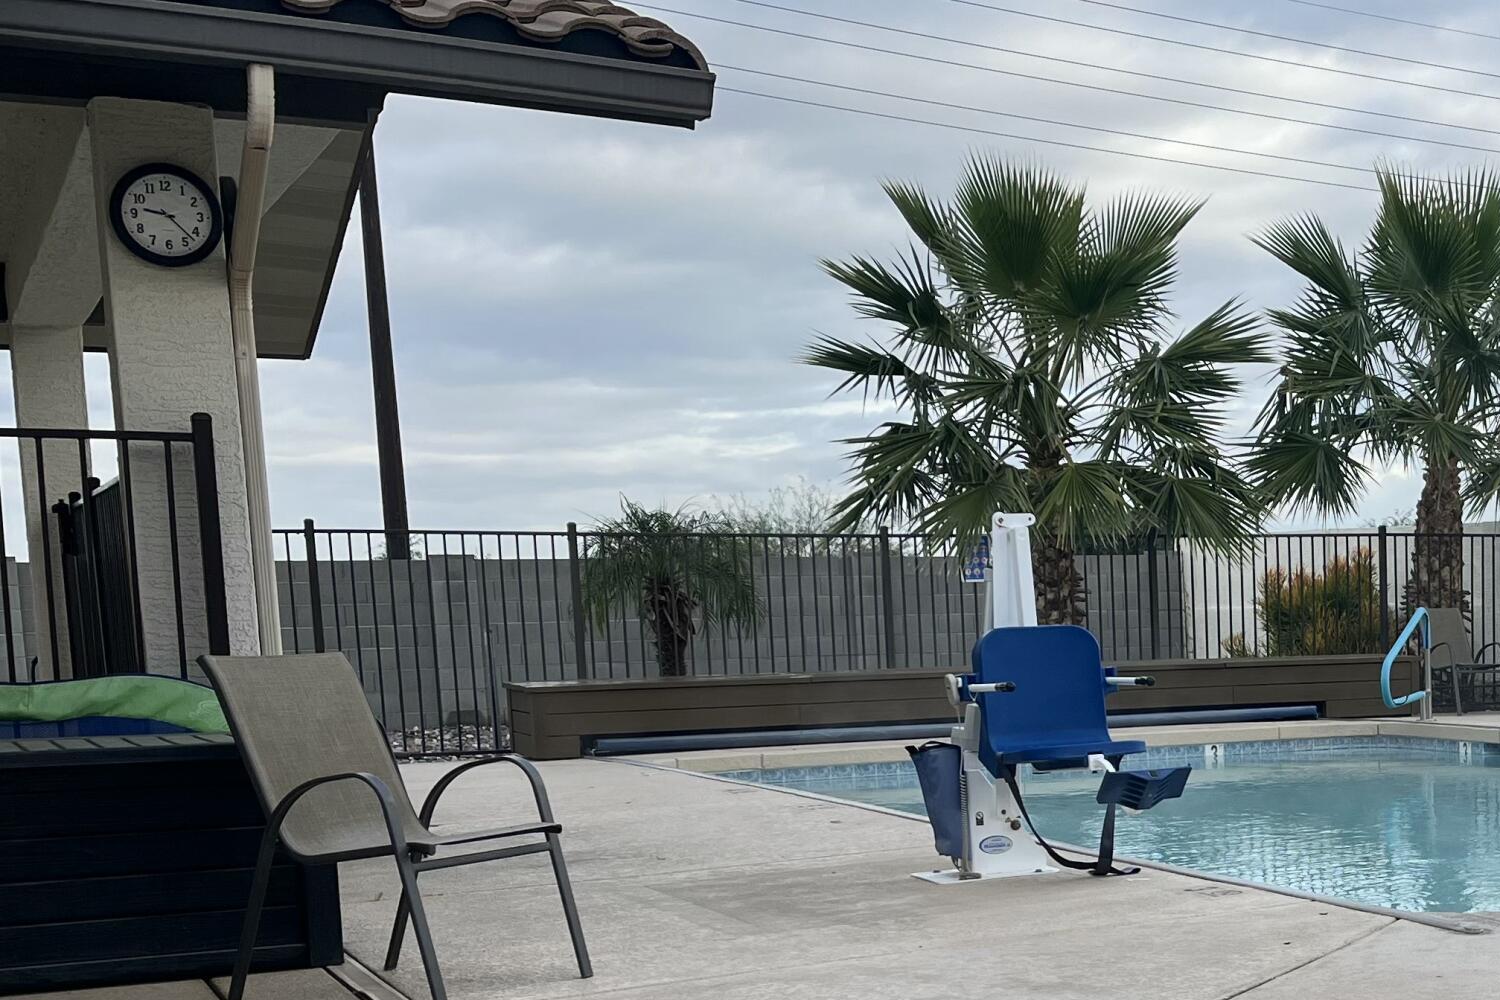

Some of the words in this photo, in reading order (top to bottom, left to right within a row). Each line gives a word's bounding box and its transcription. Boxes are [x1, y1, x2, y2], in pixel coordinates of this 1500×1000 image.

[145, 182, 155, 194] 11
[159, 180, 171, 192] 12
[179, 185, 185, 196] 1
[133, 193, 145, 204] 10
[190, 197, 198, 207] 2
[129, 208, 138, 218] 9
[196, 212, 204, 222] 3
[136, 223, 145, 234] 8
[192, 226, 200, 237] 4
[149, 235, 156, 245] 7
[165, 240, 173, 250] 6
[181, 237, 189, 247] 5
